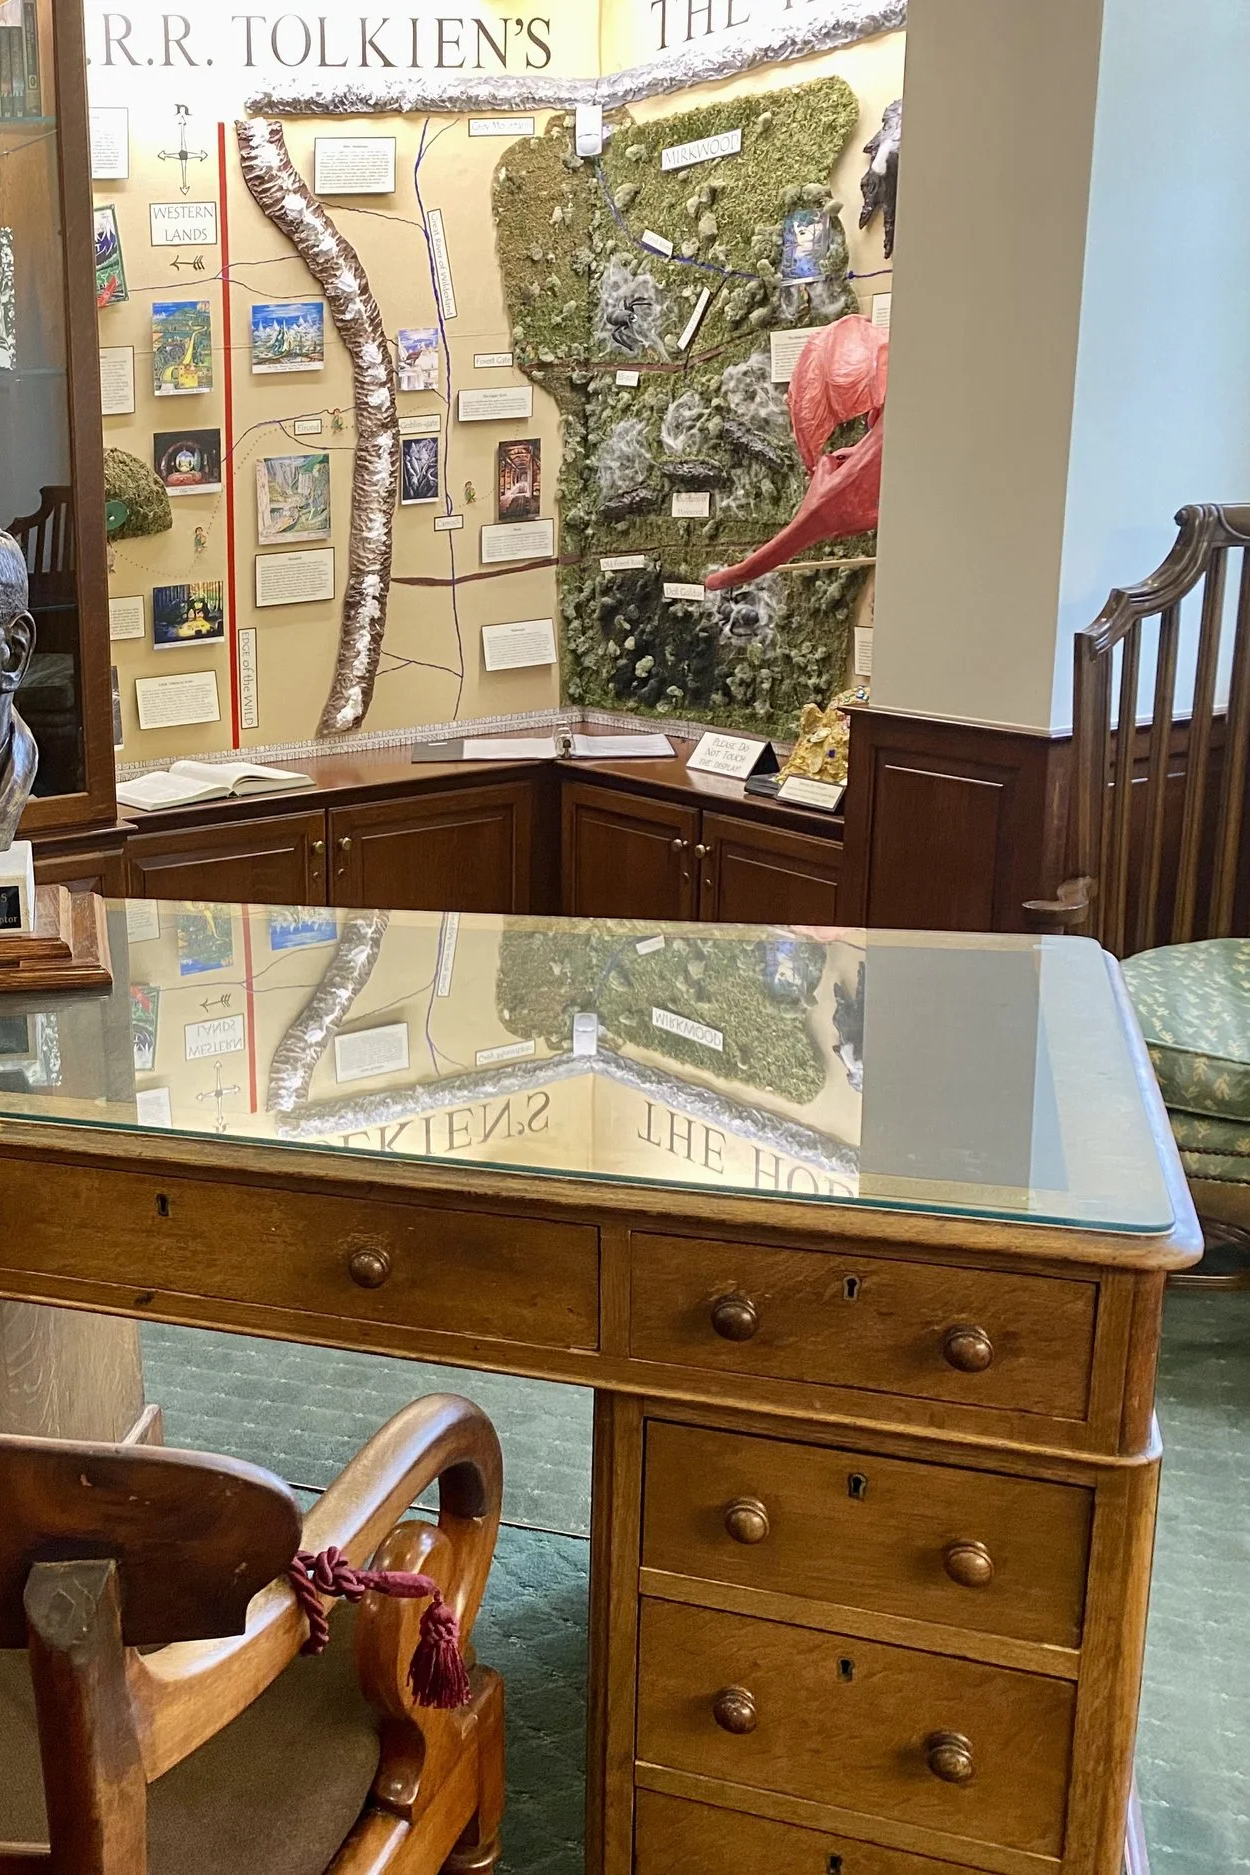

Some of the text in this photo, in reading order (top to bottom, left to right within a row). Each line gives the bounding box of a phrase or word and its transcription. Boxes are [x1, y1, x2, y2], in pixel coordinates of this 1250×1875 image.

[231, 14, 551, 69] TOLKIEN'S
[665, 133, 739, 165] MIRKWOOD
[153, 206, 214, 220] WESTERN
[165, 228, 208, 242] LANDS
[241, 632, 251, 656] EDGE
[242, 660, 255, 674] of
[244, 695, 254, 726] WILD
[712, 738, 738, 750] PLEASE
[705, 748, 747, 762] NOT TOUCH
